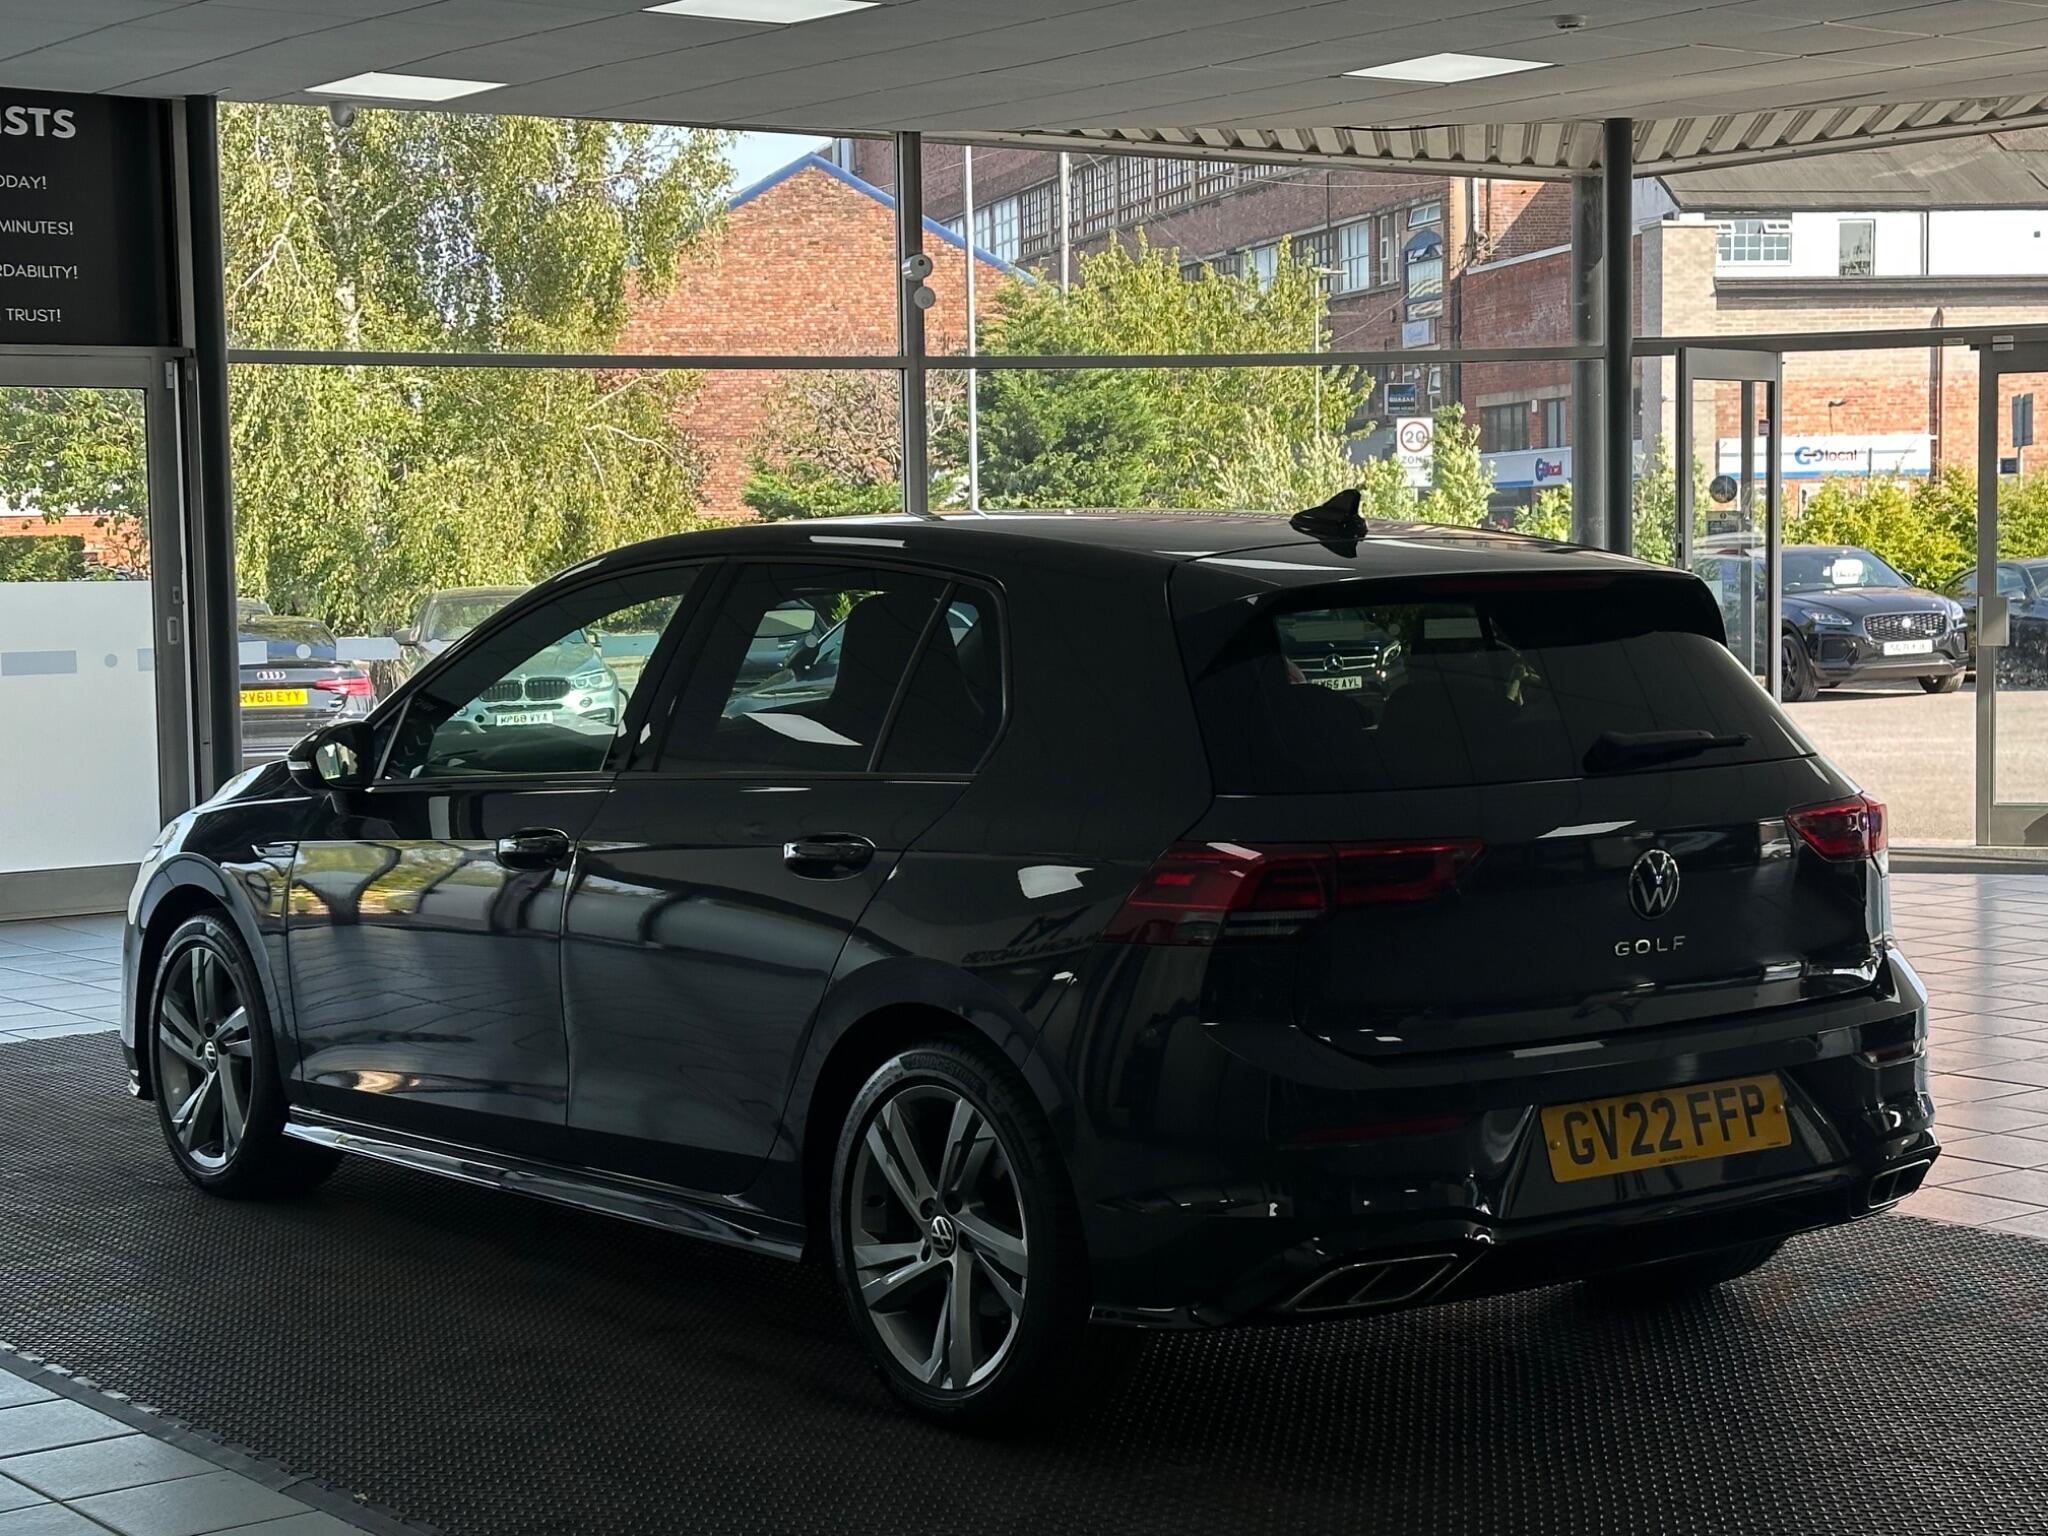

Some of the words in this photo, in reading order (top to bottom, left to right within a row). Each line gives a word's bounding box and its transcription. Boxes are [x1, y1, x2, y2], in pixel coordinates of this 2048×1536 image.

[0, 105, 76, 138] STS
[6, 308, 61, 322] TRUST!
[1405, 430, 1425, 443] 20
[1614, 935, 1686, 957] GOLF
[1563, 1097, 1683, 1165] GV22
[1687, 1084, 1766, 1147] FFP
